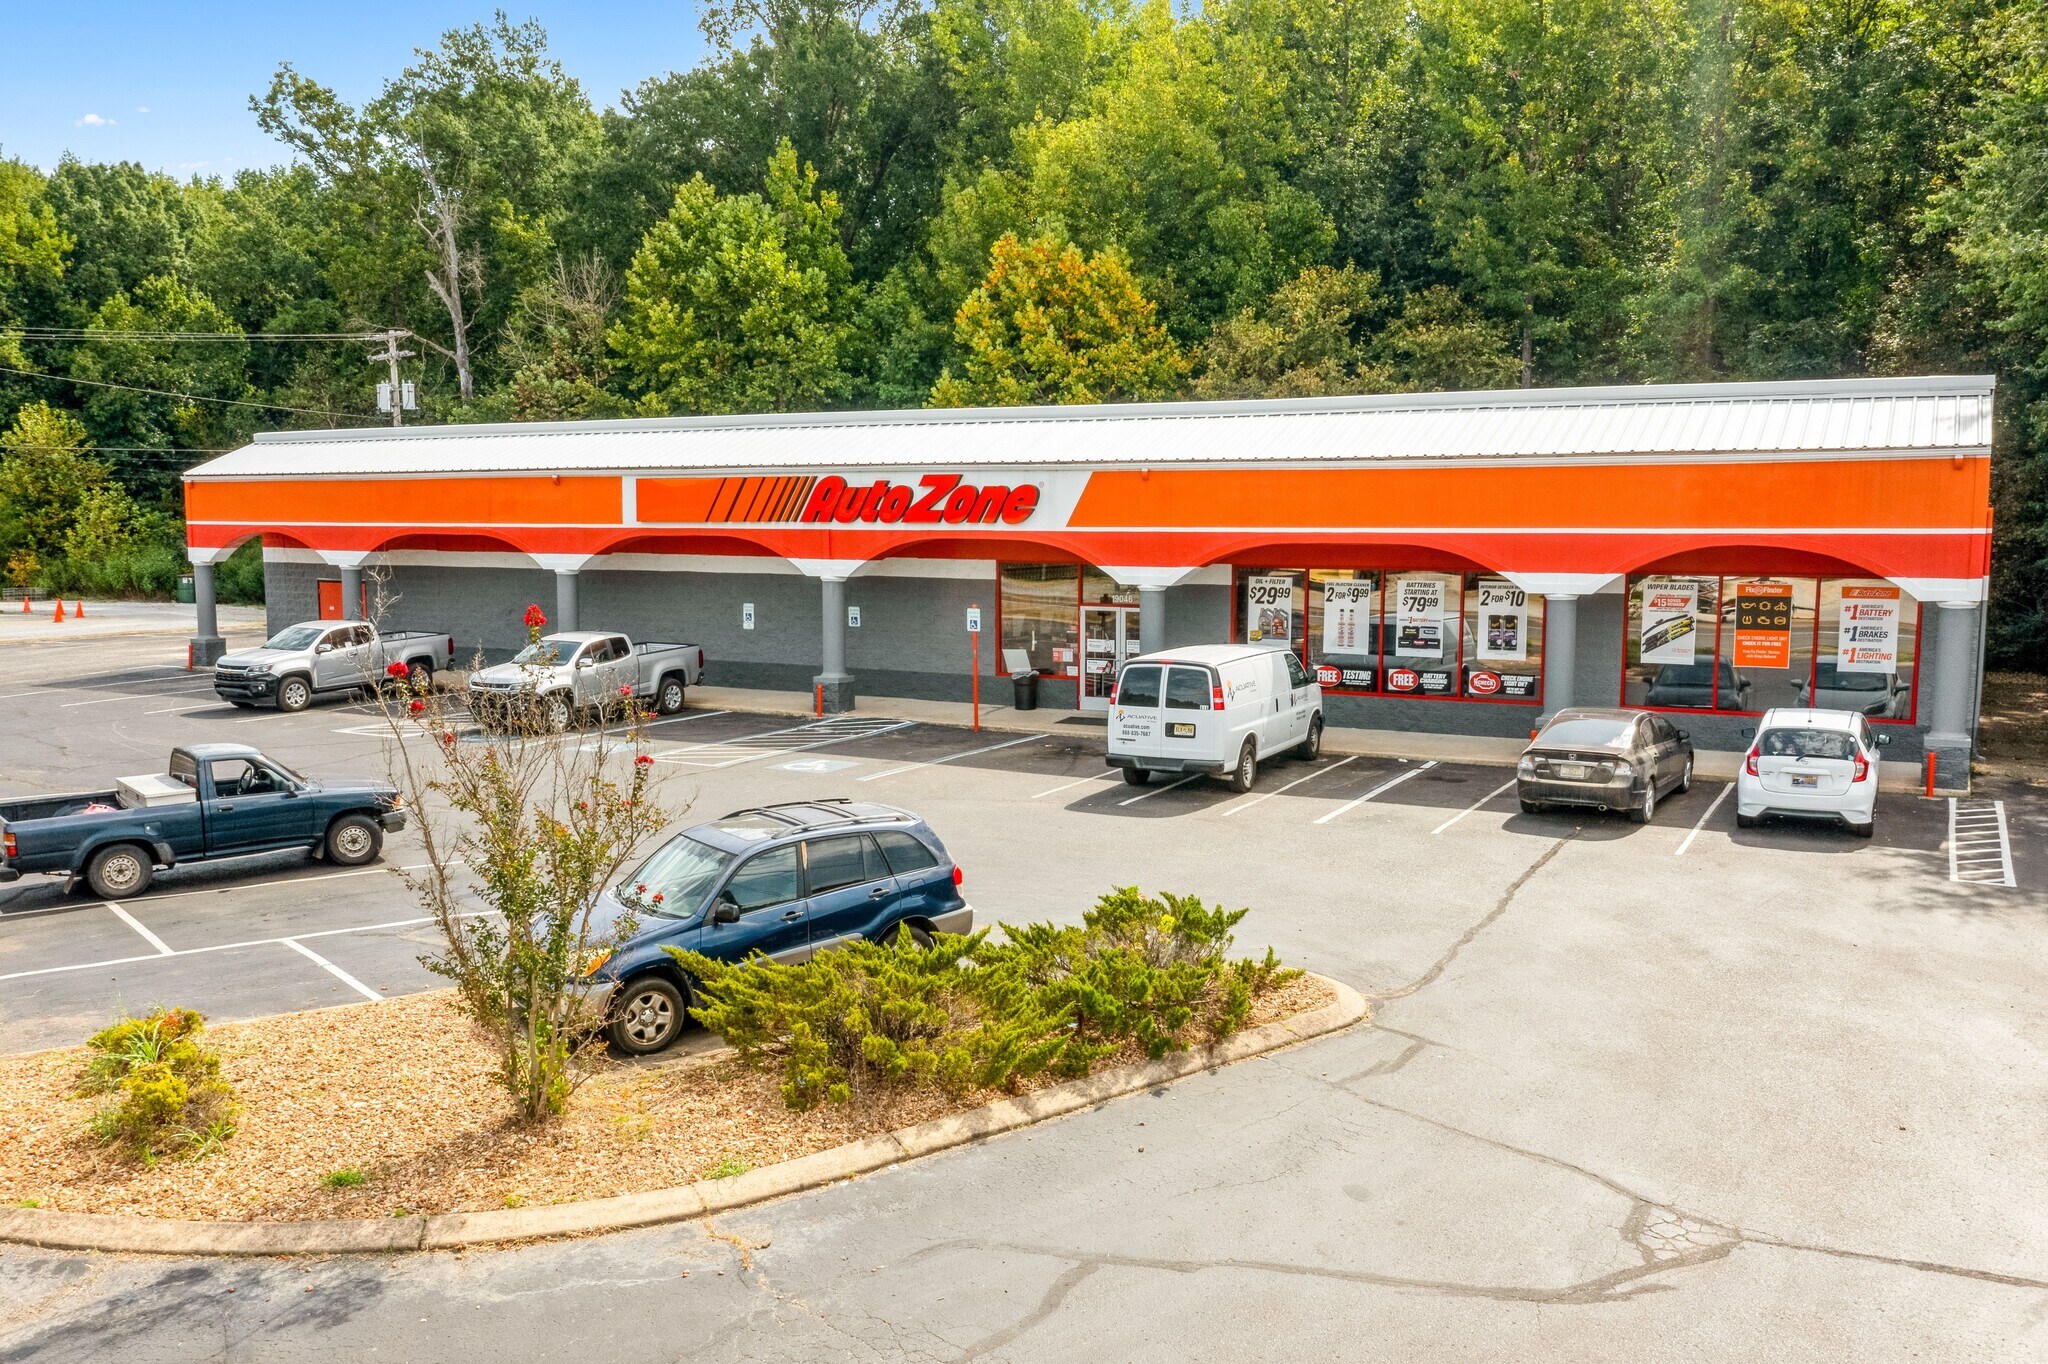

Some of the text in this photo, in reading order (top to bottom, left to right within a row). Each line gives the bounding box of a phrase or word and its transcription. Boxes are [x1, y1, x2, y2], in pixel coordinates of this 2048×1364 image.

[799, 473, 1041, 525] AutoZone
[1111, 594, 1134, 603] 19046
[1326, 587, 1334, 602] 2
[1480, 590, 1490, 606] 2
[1504, 590, 1525, 606] $10
[1654, 598, 1666, 606] $15
[1844, 604, 1858, 620] #1
[1844, 626, 1858, 641] #1
[1842, 648, 1856, 663] #1
[1857, 652, 1892, 660] LIGHTING
[1317, 670, 1338, 682] FREE
[1342, 670, 1372, 680] TESTING
[1392, 674, 1414, 686] FREE
[1236, 681, 1256, 692] ACUATIVE
